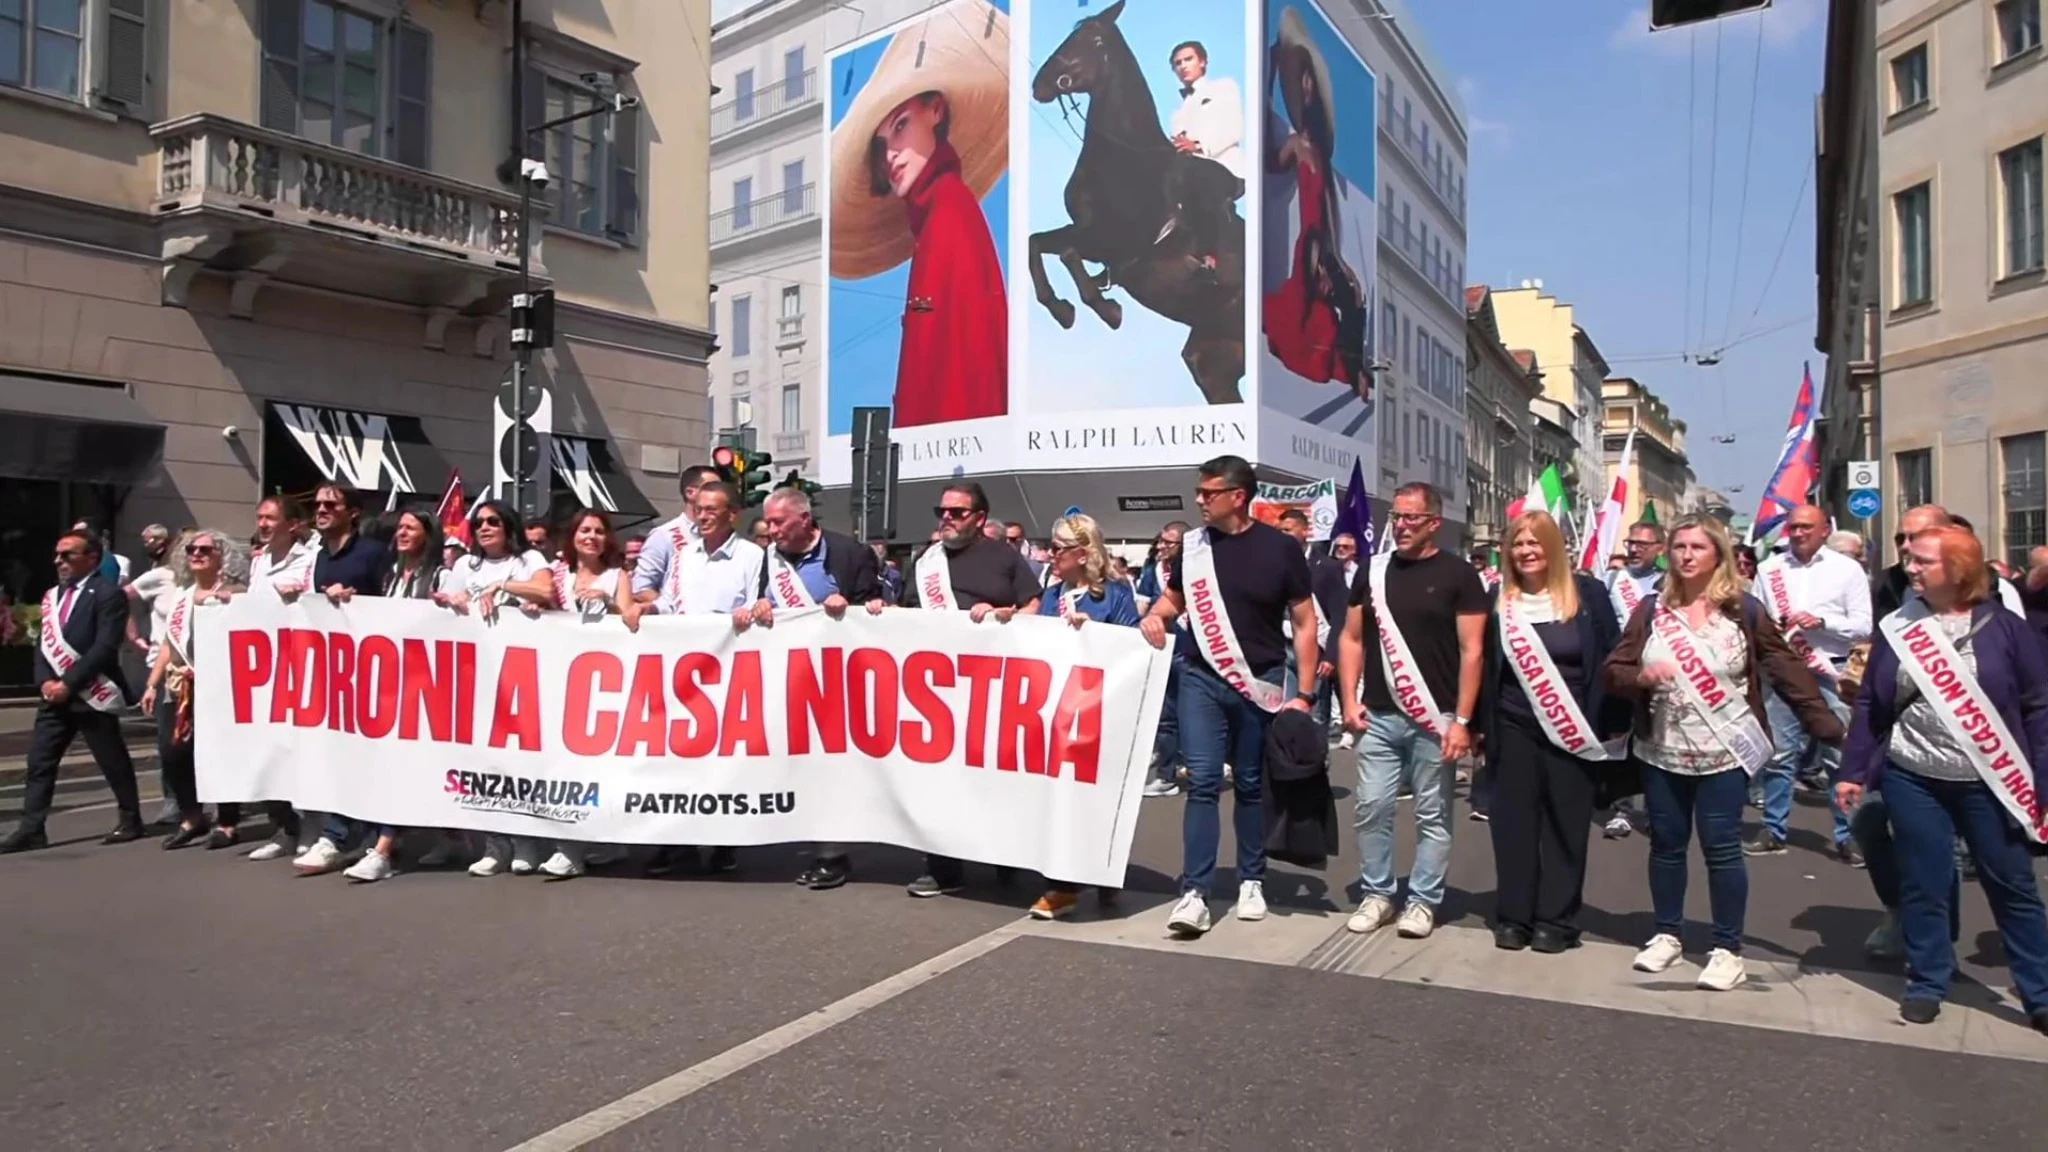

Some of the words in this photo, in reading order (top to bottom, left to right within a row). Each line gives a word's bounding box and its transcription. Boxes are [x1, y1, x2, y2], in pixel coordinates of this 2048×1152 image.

[913, 436, 982, 461] LAUREN
[1028, 428, 1116, 451] RALPH
[1134, 423, 1247, 447] LAUREN
[1292, 434, 1320, 461] RALPH
[776, 569, 806, 608] PADR
[1190, 578, 1229, 655] PADRONI
[1214, 657, 1235, 670] A
[1390, 659, 1404, 673] A
[1668, 635, 1726, 708] NOSTRA
[1902, 623, 1968, 703] NOSTRA
[229, 628, 476, 745] PADRONI
[487, 646, 542, 752] A
[562, 650, 770, 758] CASA
[787, 647, 1105, 784] NOSTRA
[1394, 673, 1428, 723] CASA
[1508, 637, 1545, 681] CASA
[1532, 679, 1585, 750] NOSTRA
[1953, 697, 2000, 755] CASA
[1990, 750, 2015, 771] A
[444, 768, 599, 808] SENZAPAURA
[624, 792, 795, 815] PATRIOTS.EU
